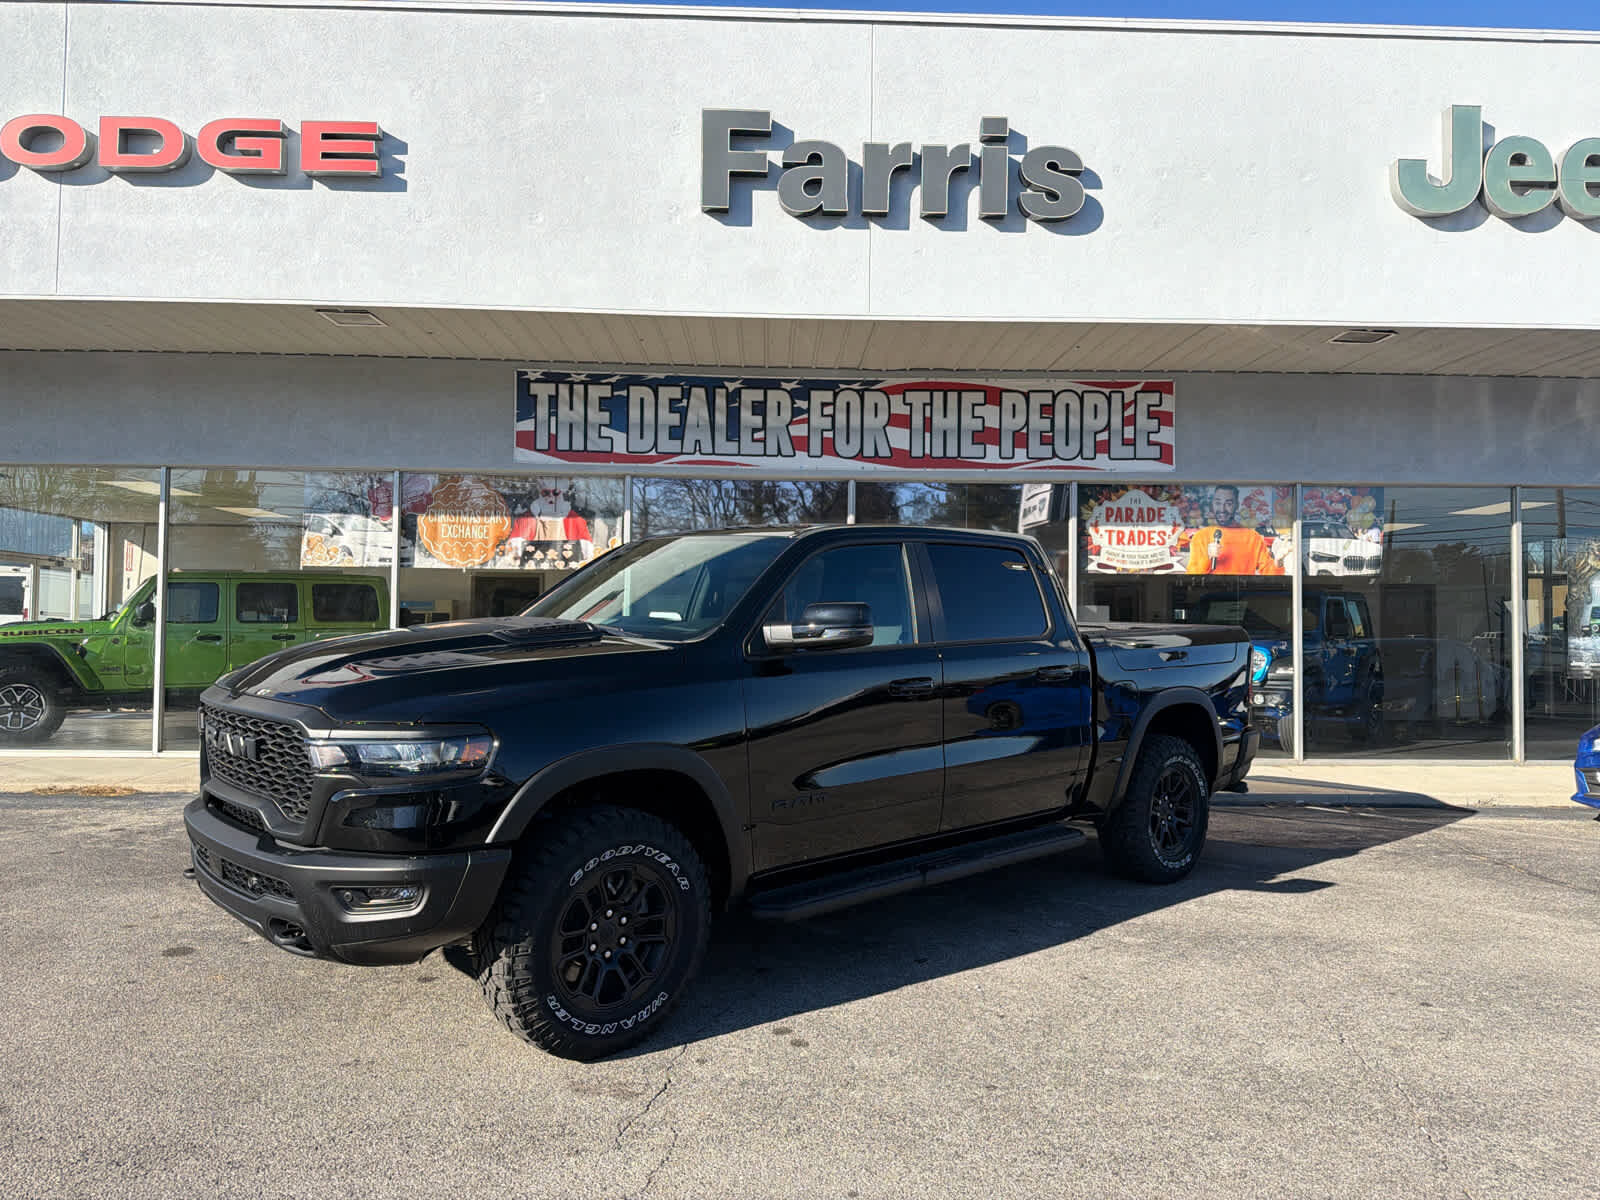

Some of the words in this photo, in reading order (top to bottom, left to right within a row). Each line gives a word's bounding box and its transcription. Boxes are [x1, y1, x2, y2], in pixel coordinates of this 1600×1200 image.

[702, 107, 1085, 222] Farris
[529, 381, 614, 454] THE
[626, 384, 796, 457] DEALER
[807, 387, 893, 460] FOR
[902, 388, 987, 460] THE
[999, 388, 1163, 461] PEOPLE
[428, 508, 481, 523] CHRISTMAS
[483, 510, 502, 524] CAR
[441, 524, 489, 539] EXCHANGE
[1105, 507, 1167, 523] PARADE
[1104, 529, 1167, 546] TRADES
[205, 722, 257, 761] RAM
[569, 844, 690, 890] GOODYEAR
[547, 991, 668, 1035] WRANGLER
